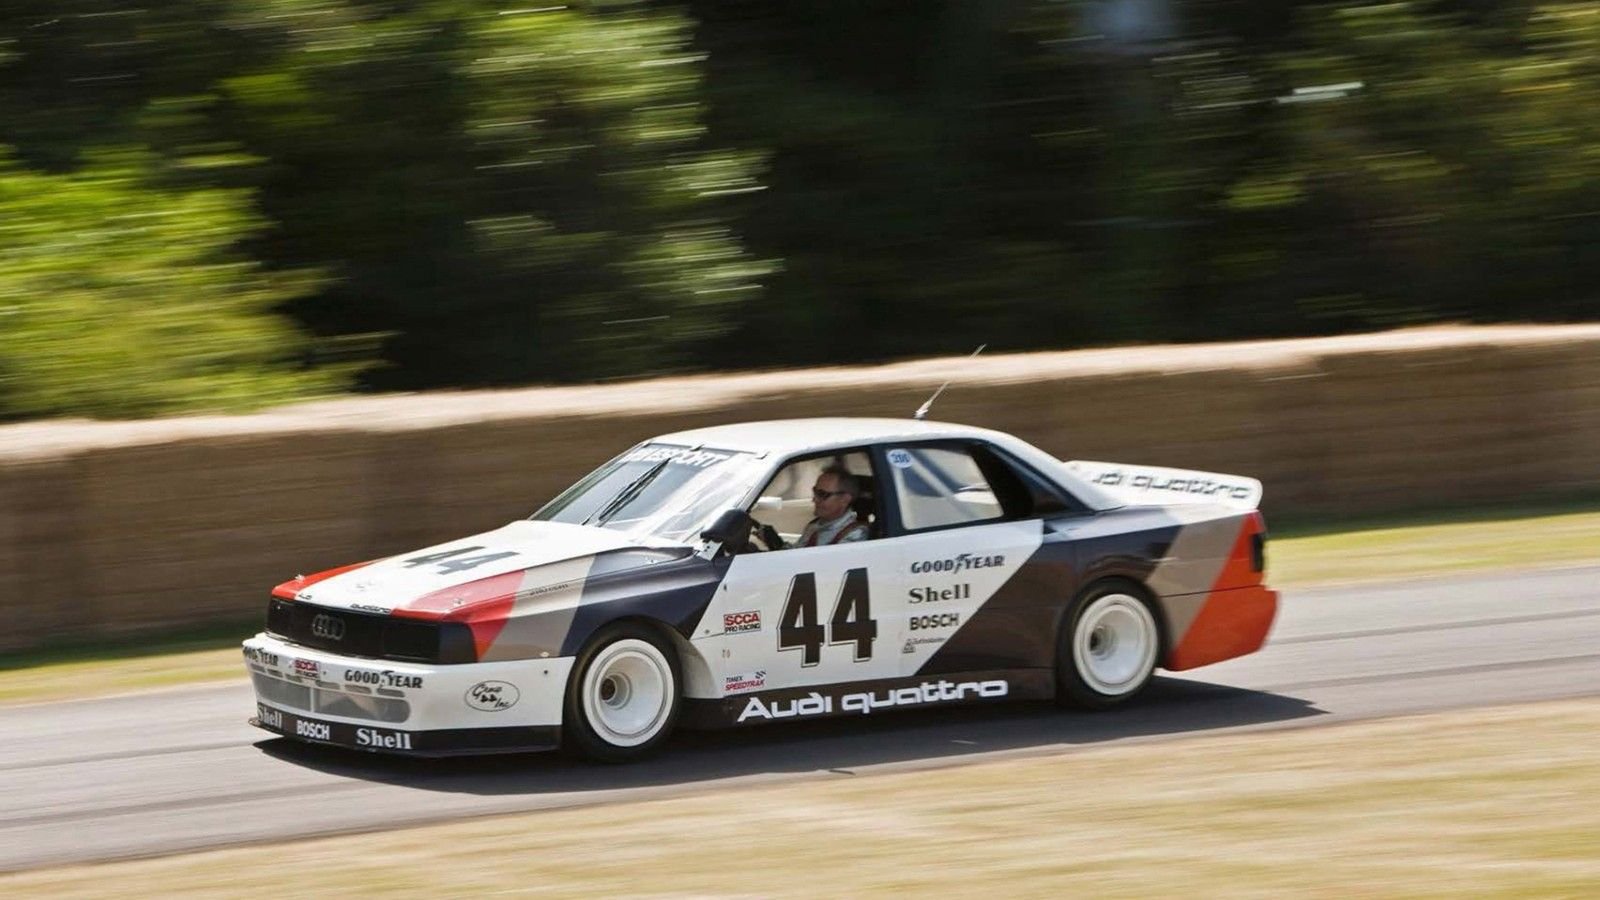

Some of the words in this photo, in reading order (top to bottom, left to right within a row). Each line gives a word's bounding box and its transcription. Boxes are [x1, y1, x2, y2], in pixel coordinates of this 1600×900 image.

[1130, 474, 1249, 498] quattro
[402, 546, 520, 575] 44
[909, 583, 971, 604] Shell
[725, 612, 760, 626] SCCA
[776, 567, 877, 668] 44
[910, 613, 960, 630] BOSCH
[737, 692, 832, 723] Audi
[841, 679, 1009, 714] quattro
[296, 719, 331, 741] BOSCH
[356, 727, 413, 750] Shell
